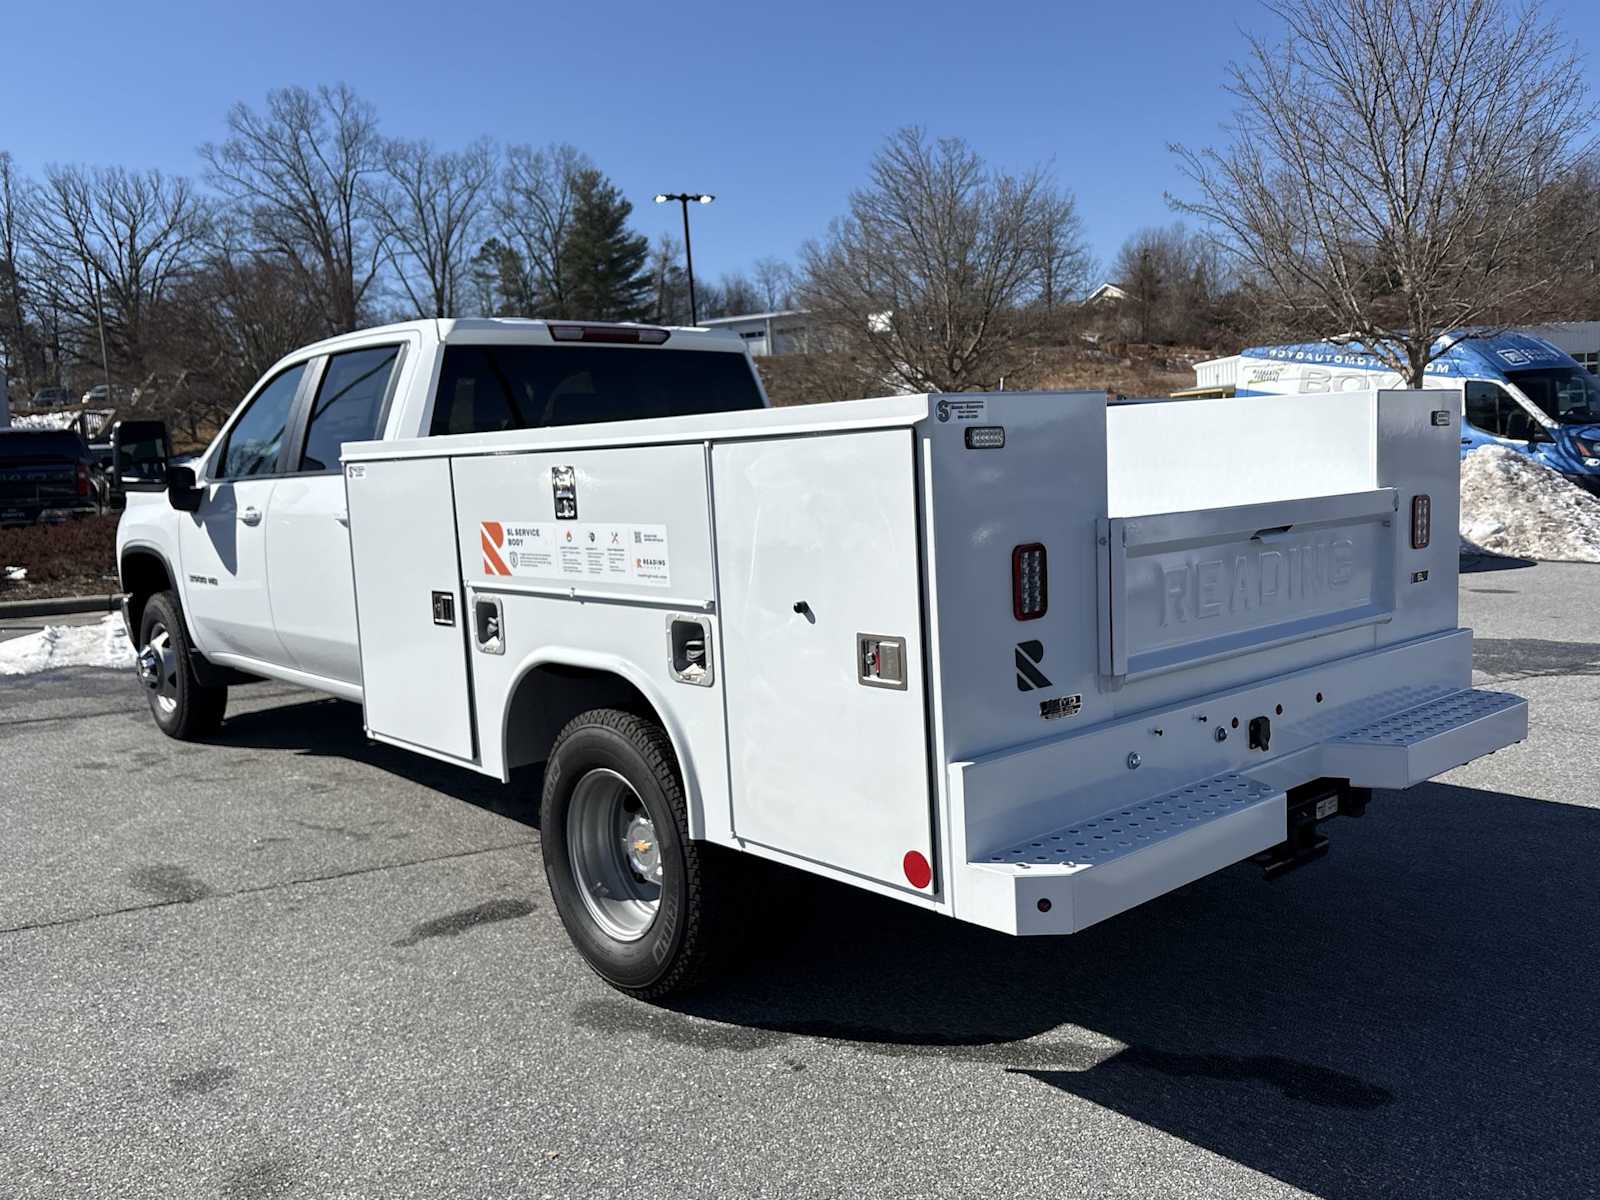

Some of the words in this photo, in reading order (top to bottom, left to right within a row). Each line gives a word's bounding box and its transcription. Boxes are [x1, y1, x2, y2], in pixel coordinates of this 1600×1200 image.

[515, 528, 540, 537] SERVICE
[508, 538, 524, 547] BODY
[642, 558, 666, 567] READING
[1158, 537, 1353, 629] READING
